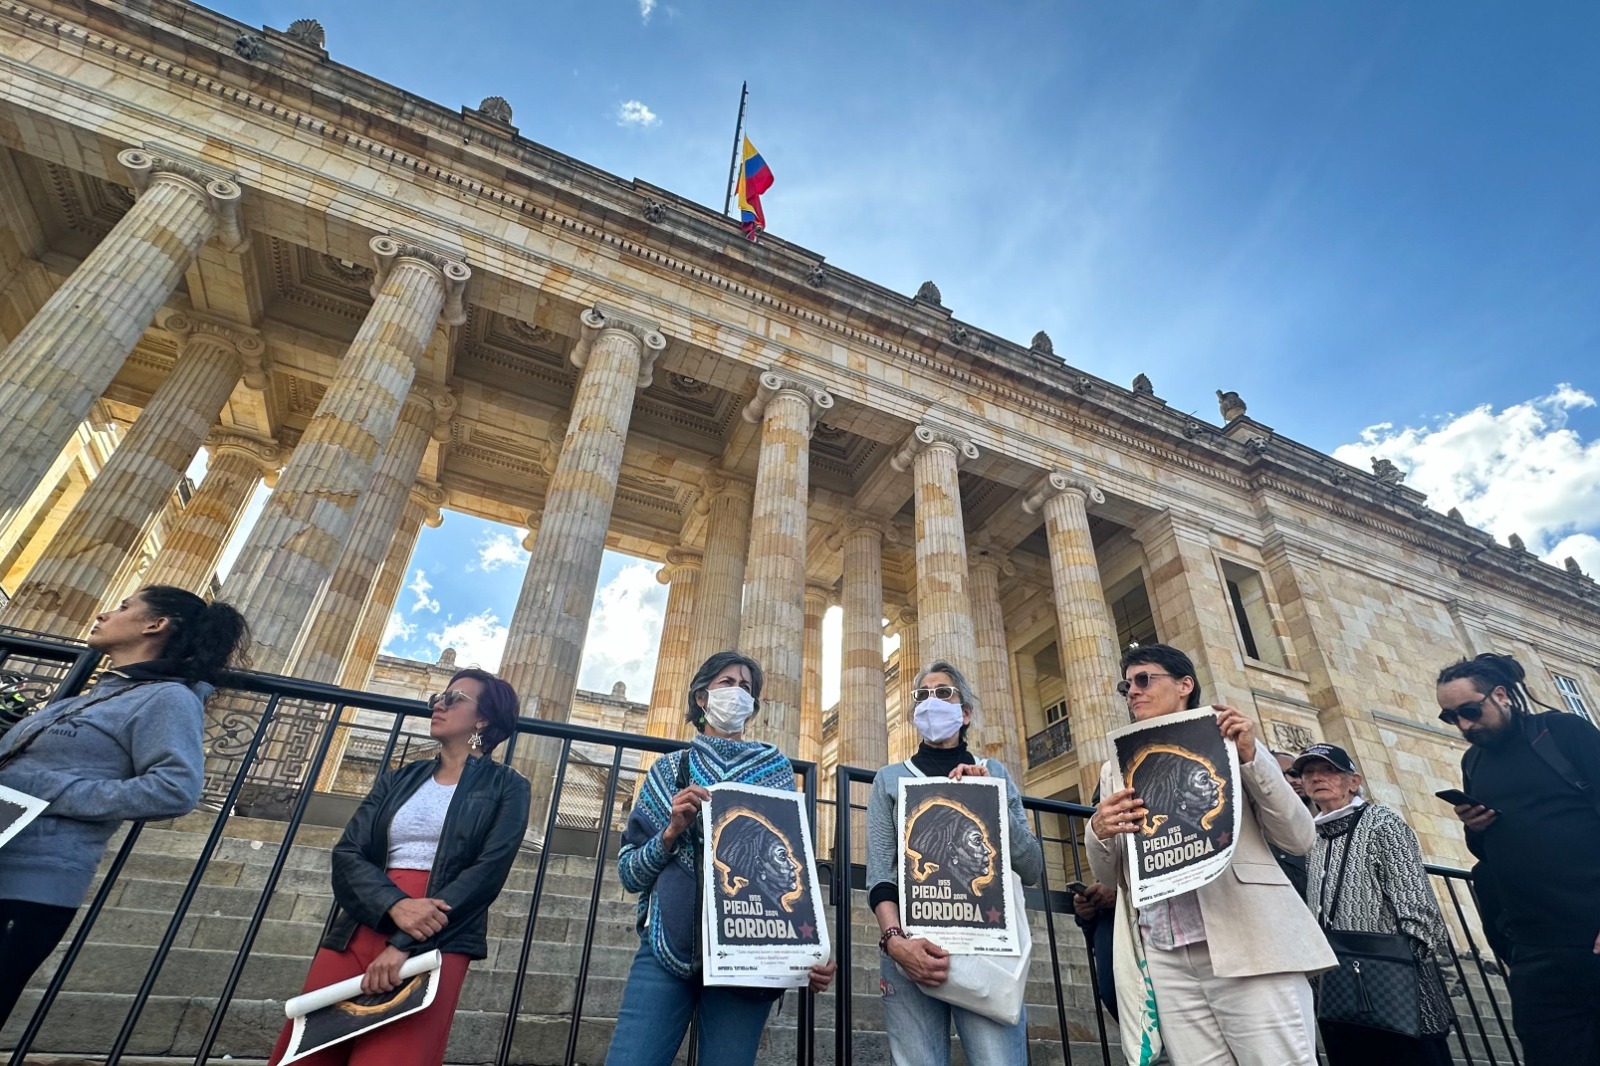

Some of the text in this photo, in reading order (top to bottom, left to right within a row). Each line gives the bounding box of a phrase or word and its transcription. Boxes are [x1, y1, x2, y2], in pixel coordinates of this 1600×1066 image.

[1142, 831, 1183, 853] PIEDAD
[1144, 836, 1215, 873] CORDOBA
[911, 885, 952, 900] PIEDAD
[722, 899, 764, 916] PIEDAD
[911, 901, 985, 923] CORDOBA
[723, 917, 799, 939] CORDOBA
